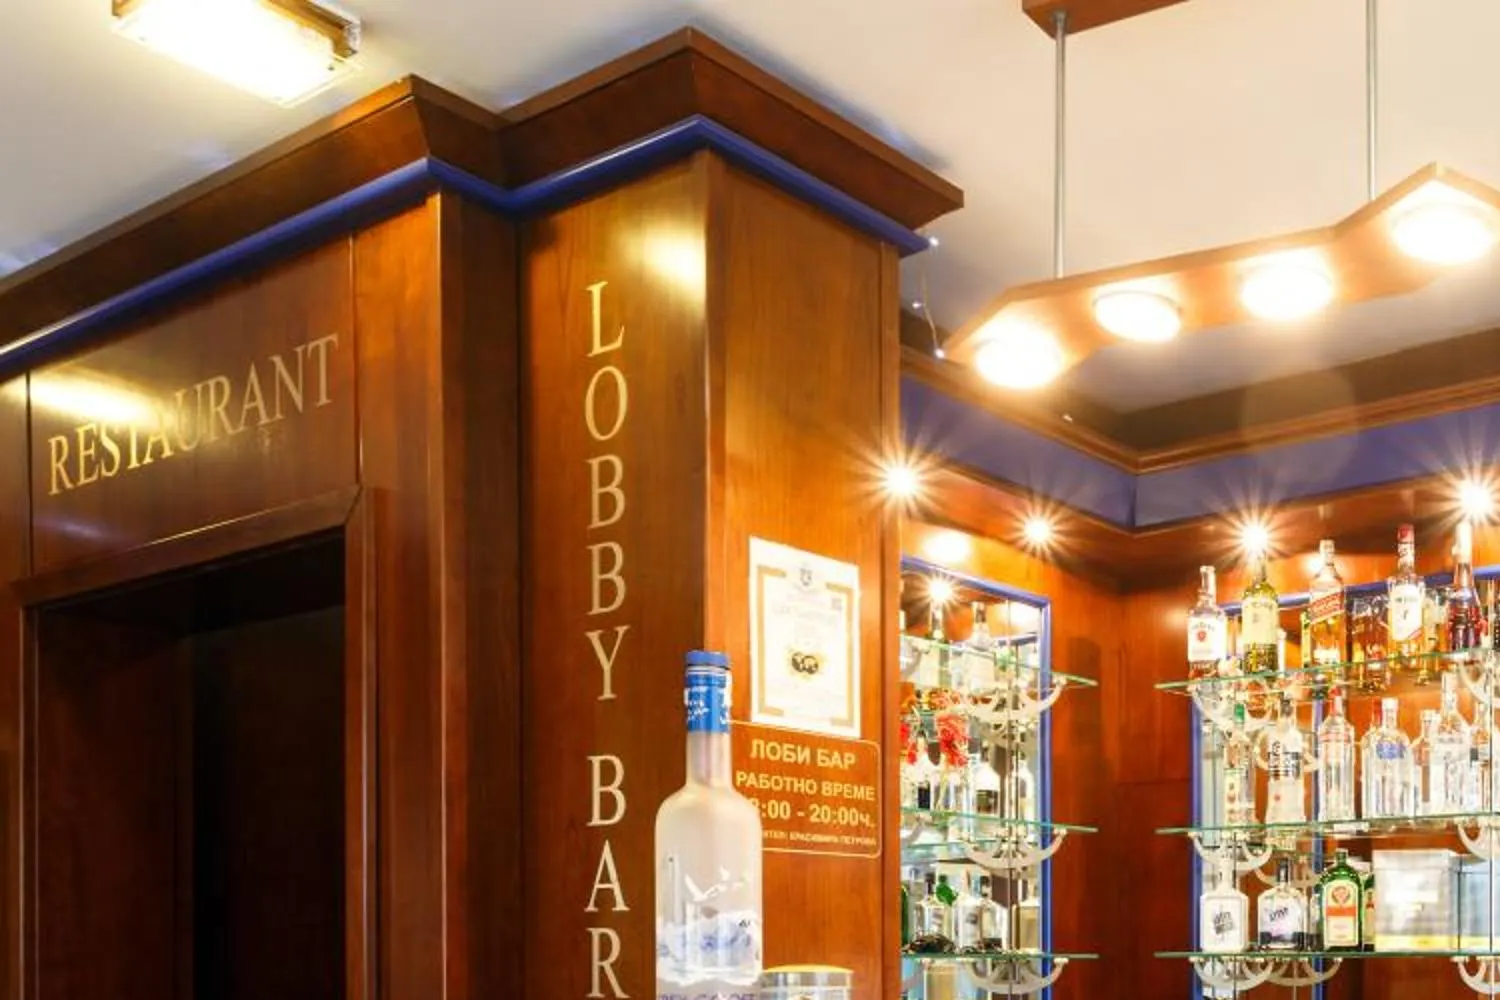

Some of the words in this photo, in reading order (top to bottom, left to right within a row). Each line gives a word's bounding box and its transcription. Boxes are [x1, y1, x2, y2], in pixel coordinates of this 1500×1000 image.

[48, 333, 339, 496] RESTAURANT
[585, 280, 630, 701] LOBBY
[735, 770, 817, 795] РАБОТНО
[821, 781, 877, 801] ВРЕМЕ
[749, 738, 811, 765] ЛОБИ
[816, 748, 857, 770] БАР
[585, 754, 631, 1000] BAR
